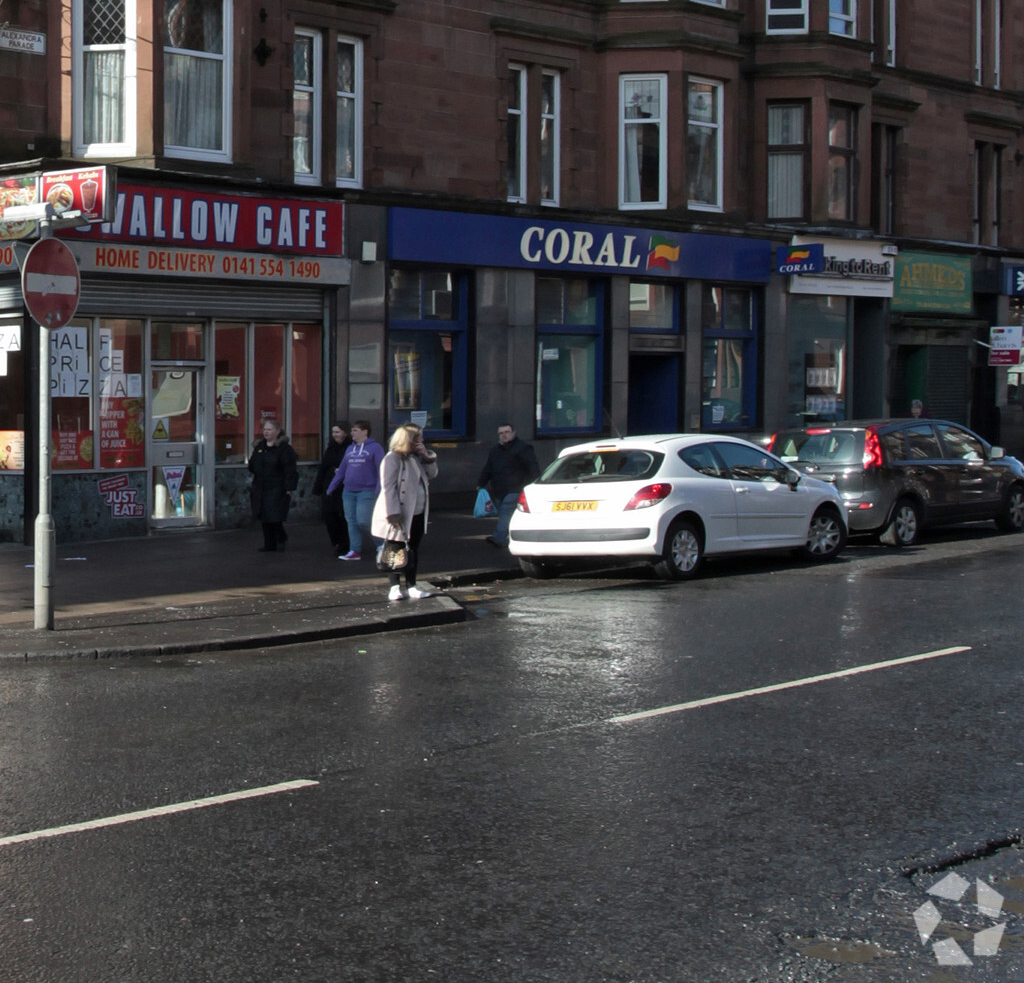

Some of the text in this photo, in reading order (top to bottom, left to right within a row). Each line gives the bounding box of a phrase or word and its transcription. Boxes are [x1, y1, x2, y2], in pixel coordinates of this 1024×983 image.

[1, 31, 42, 43] ALEXANDRA
[8, 39, 35, 50] PARADE
[75, 192, 327, 249] WALLOW CAFE
[520, 226, 641, 268] CORAL
[95, 247, 321, 280] HOME DELIVERY 0141 554 1490
[779, 263, 815, 273] CORAL
[823, 256, 849, 276] king
[101, 419, 118, 429] WITH
[101, 439, 127, 448] OF JUICE
[106, 491, 137, 503] JUST
[114, 504, 136, 516] EAT
